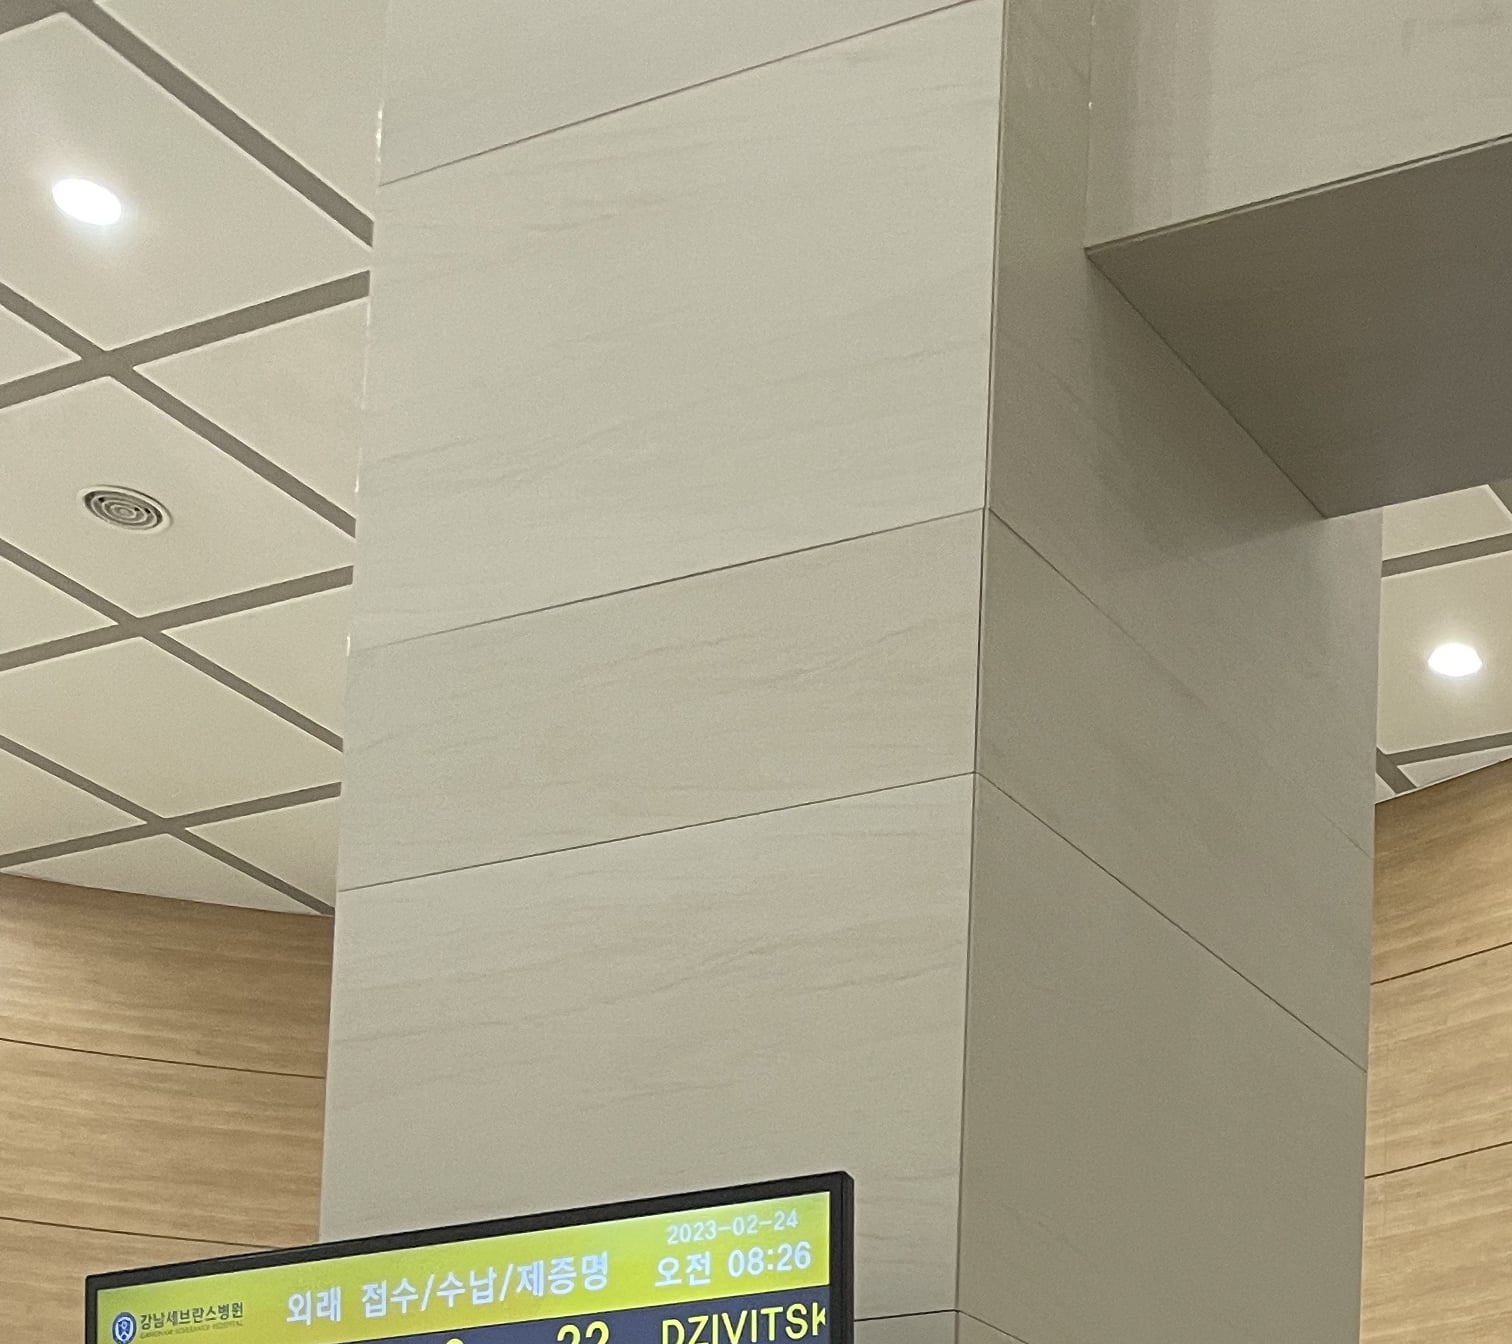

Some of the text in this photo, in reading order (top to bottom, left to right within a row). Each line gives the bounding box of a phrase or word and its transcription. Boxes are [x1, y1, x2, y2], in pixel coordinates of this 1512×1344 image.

[666, 1208, 799, 1246] 2023-02-24
[654, 1240, 813, 1289] 오전 08:26
[285, 1251, 610, 1327] 외래 접수/수납/제증명
[140, 1301, 244, 1331] 강남세브란스병원
